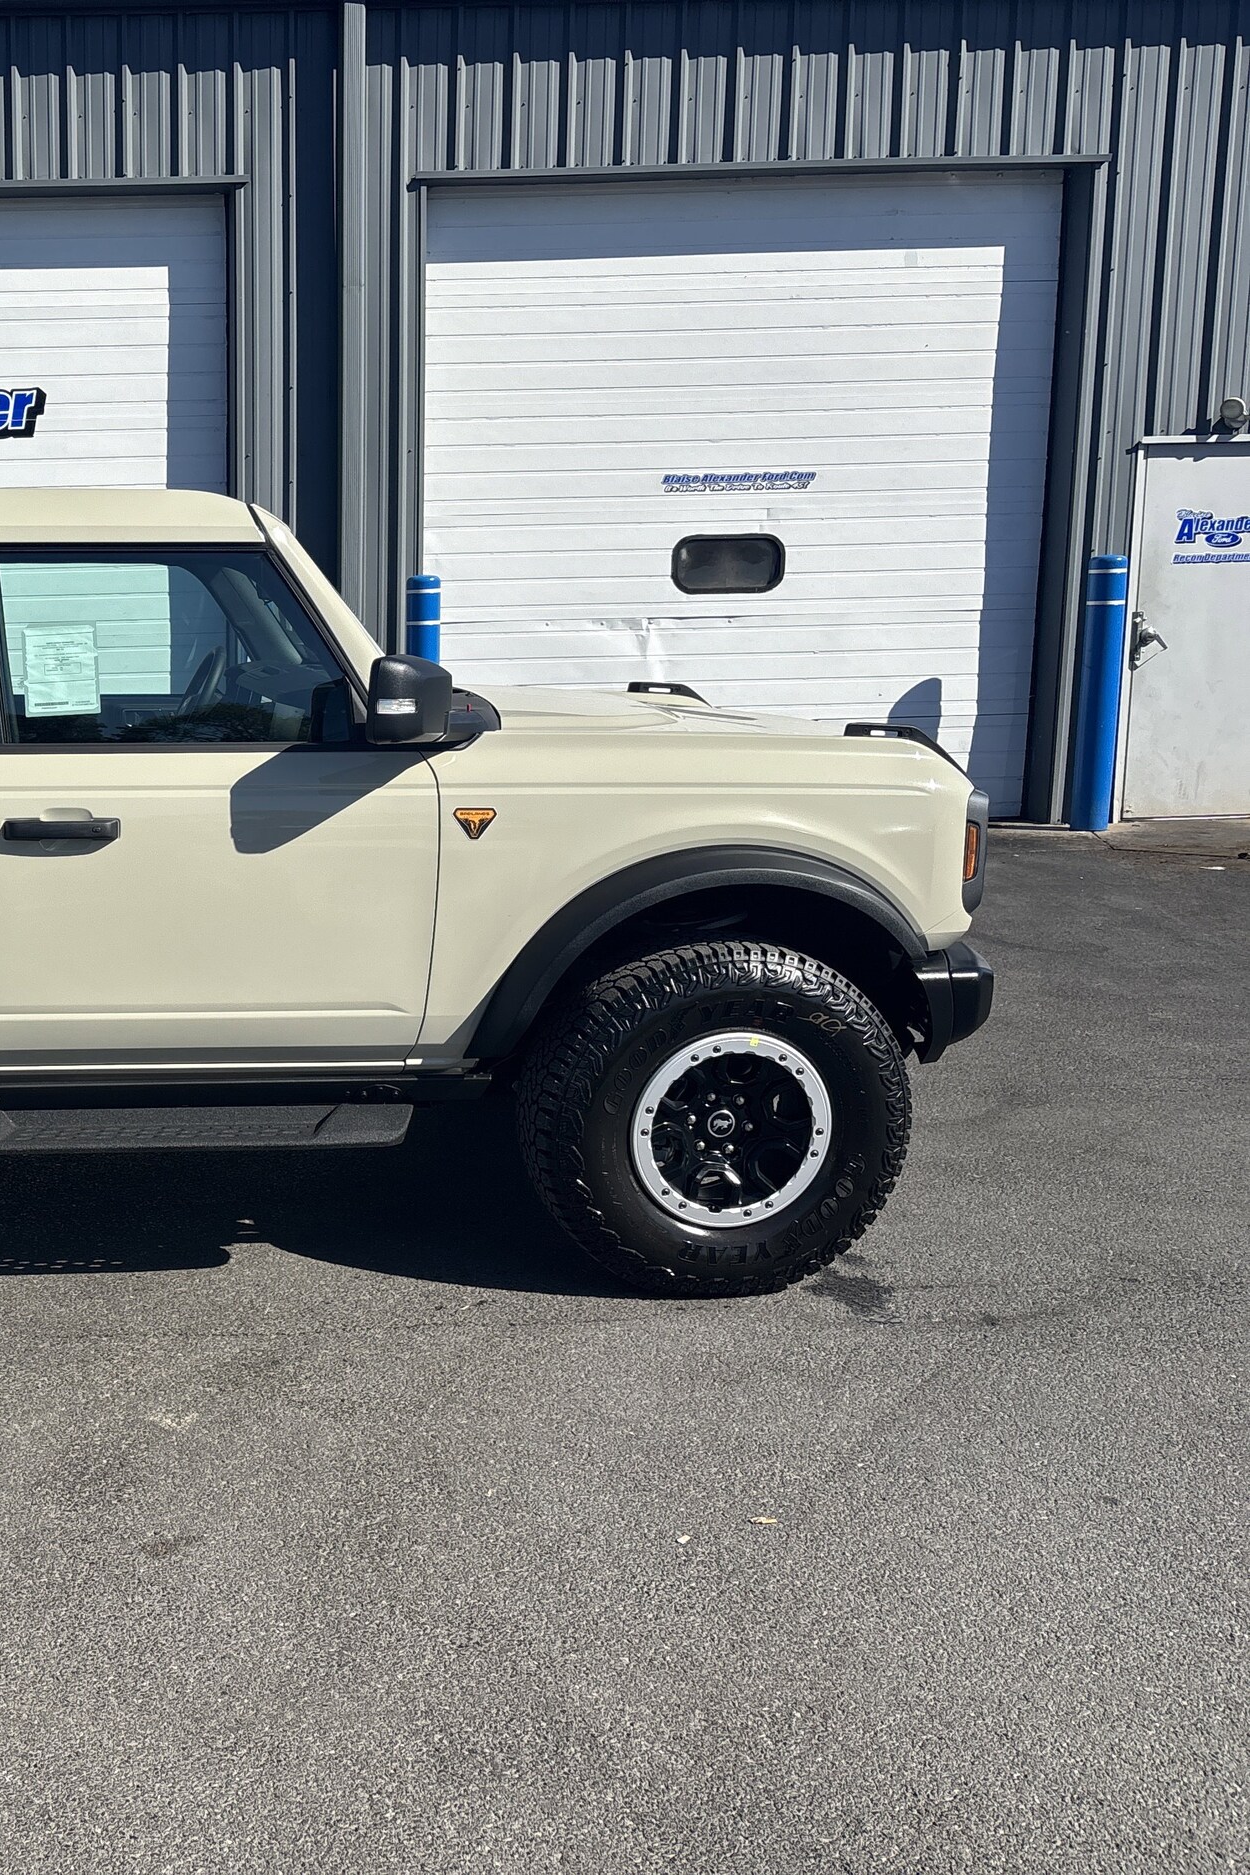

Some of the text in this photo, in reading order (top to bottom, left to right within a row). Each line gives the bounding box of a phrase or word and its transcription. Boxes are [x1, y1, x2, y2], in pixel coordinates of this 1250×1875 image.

[662, 474, 700, 484] Blaise
[701, 472, 761, 484] Alexander
[1212, 534, 1232, 543] Ford
[1173, 554, 1204, 564] Recon
